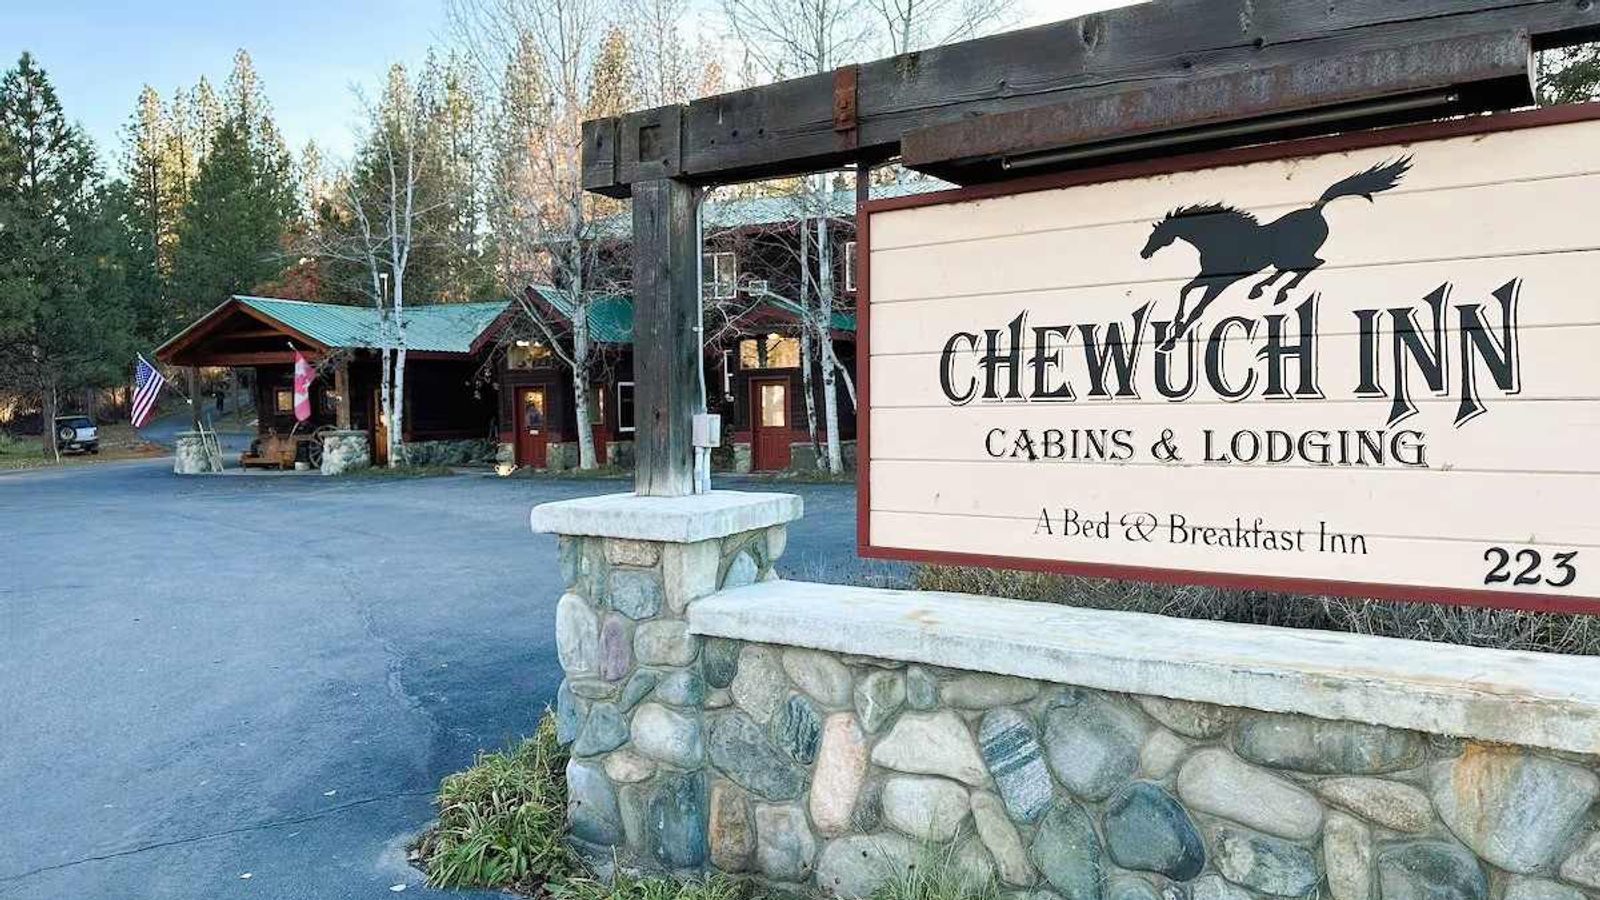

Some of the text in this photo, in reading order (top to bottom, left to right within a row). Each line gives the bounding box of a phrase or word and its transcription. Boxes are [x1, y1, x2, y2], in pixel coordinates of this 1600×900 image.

[939, 276, 1523, 429] CHEWUCH INN
[985, 427, 1429, 468] CABINS & LODGING
[1034, 508, 1368, 555] A Bed & Breakfast Inn
[1483, 546, 1579, 588] 223
